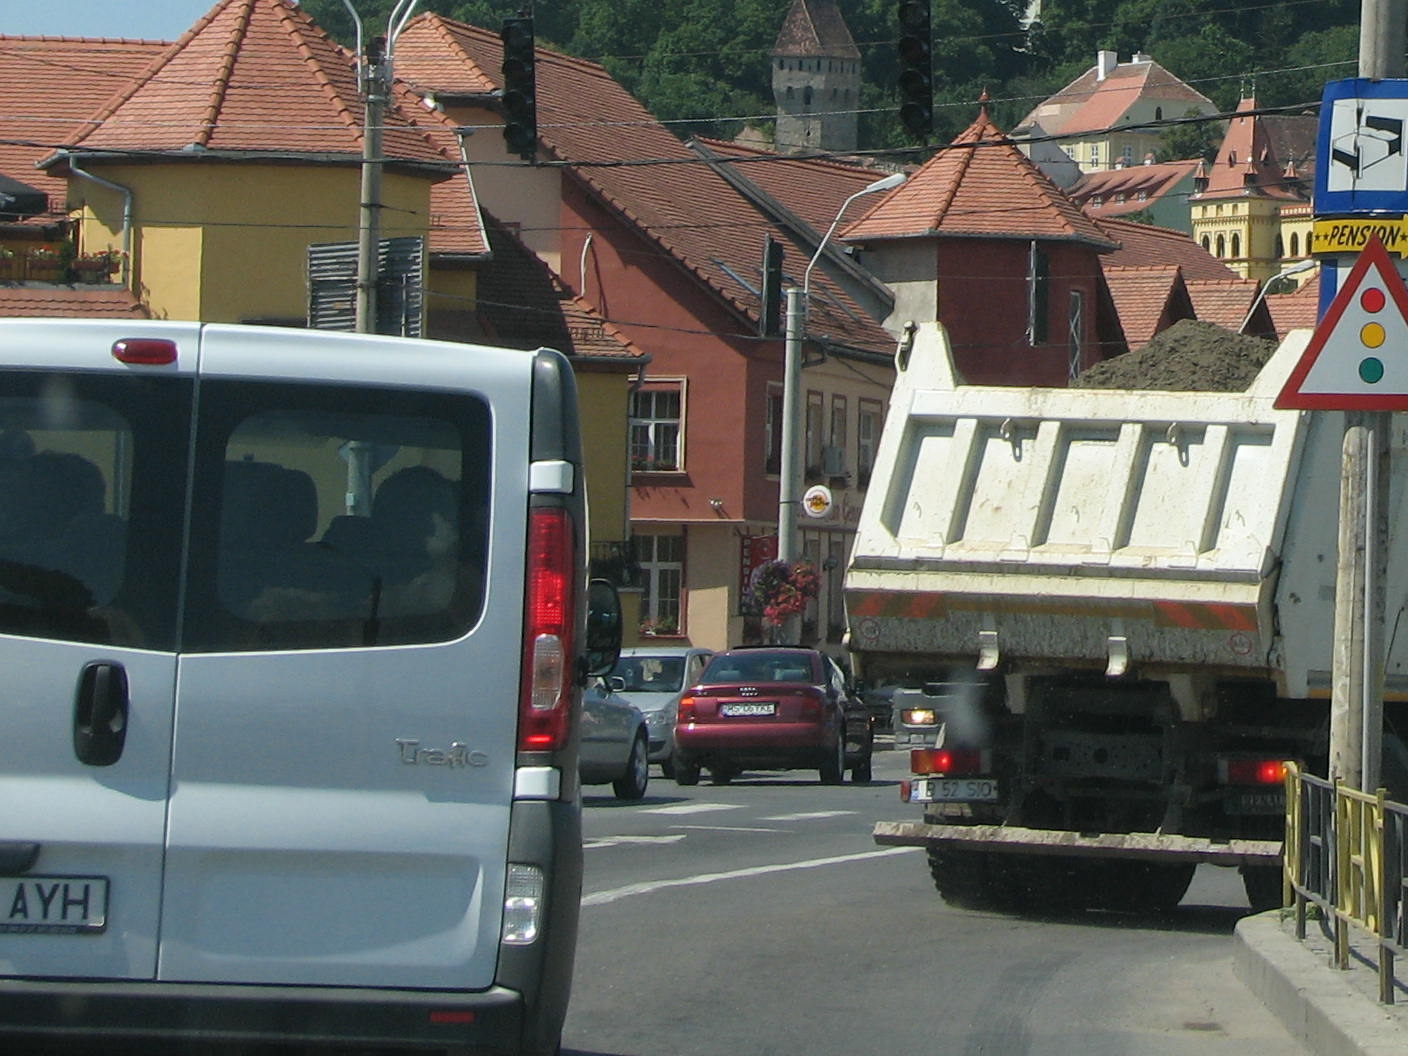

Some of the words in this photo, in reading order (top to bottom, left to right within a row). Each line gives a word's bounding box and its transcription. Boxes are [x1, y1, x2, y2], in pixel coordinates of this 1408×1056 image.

[394, 737, 489, 769] Trafic
[926, 781, 936, 797] B
[942, 781, 958, 797] 52
[8, 882, 91, 921] AYH
